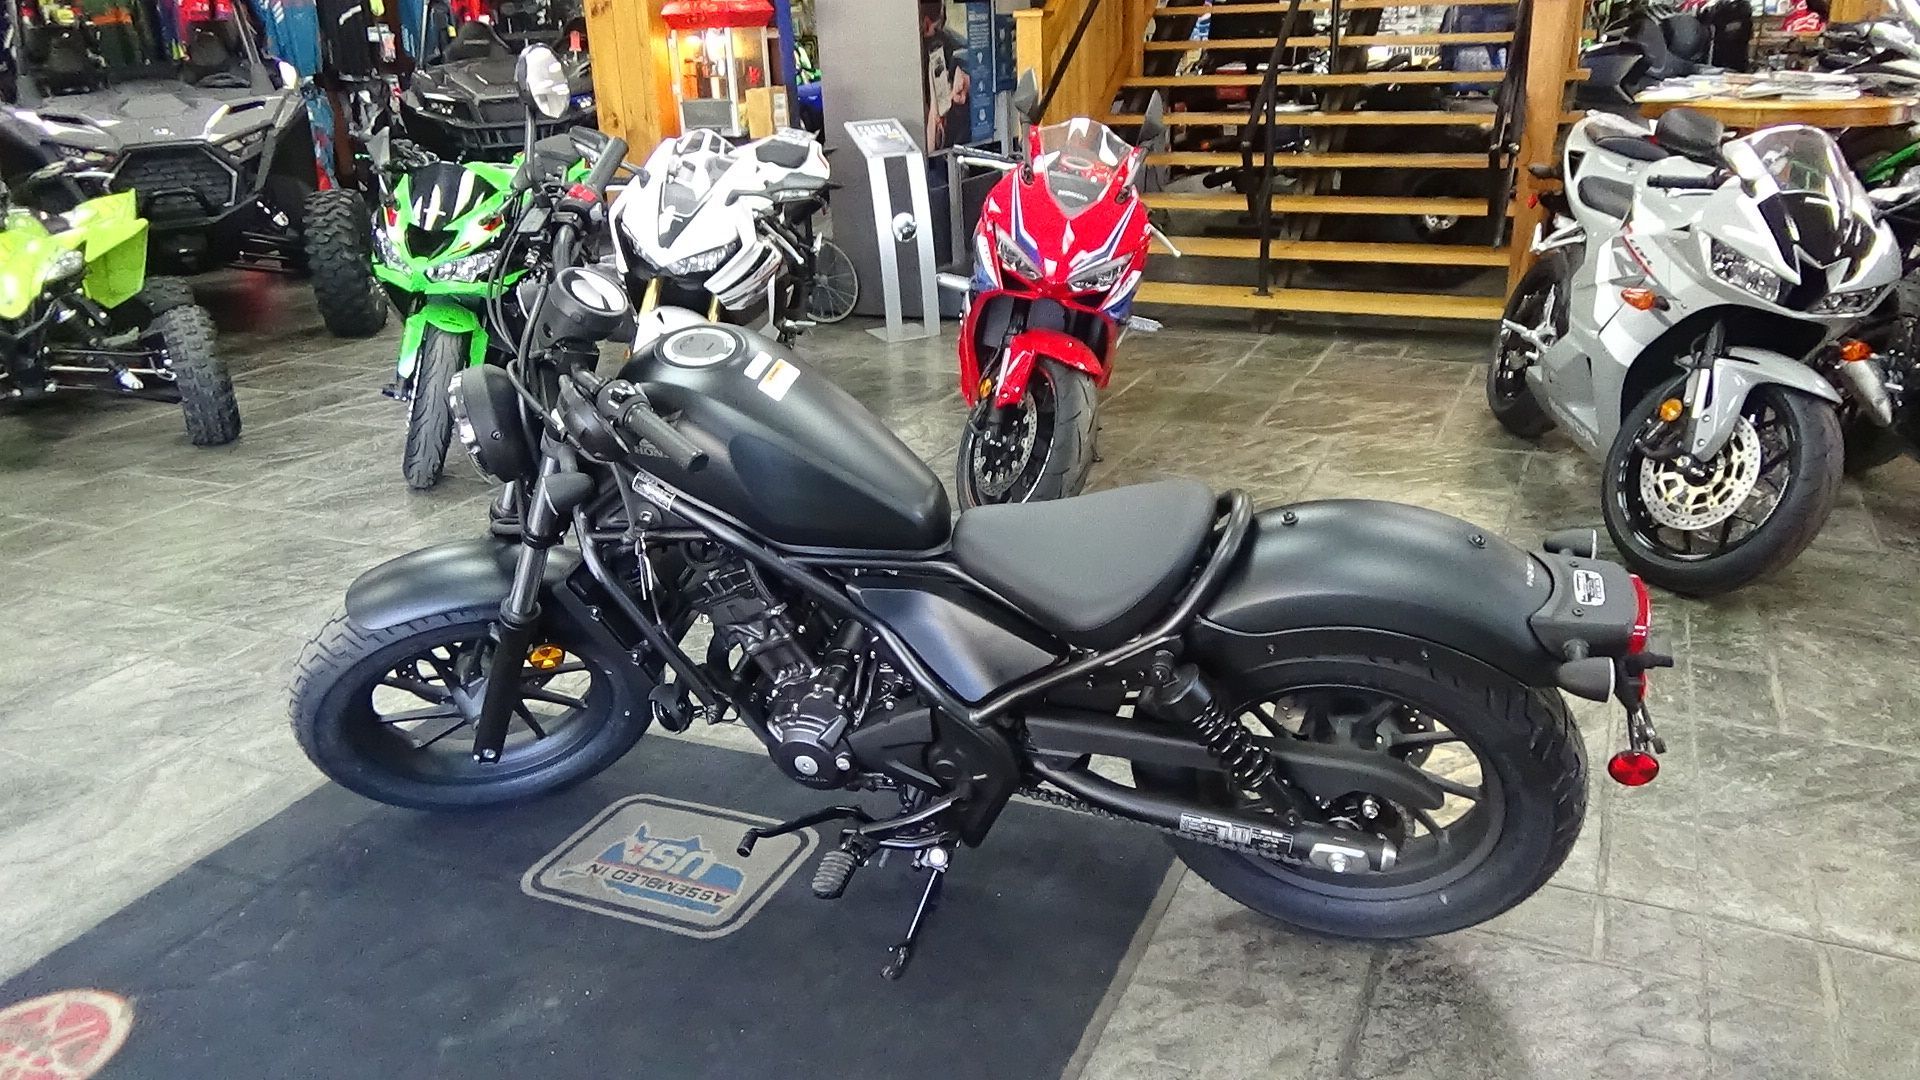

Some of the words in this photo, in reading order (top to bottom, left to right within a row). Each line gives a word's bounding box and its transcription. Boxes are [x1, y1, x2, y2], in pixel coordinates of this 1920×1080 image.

[586, 863, 610, 876] IN
[622, 838, 713, 881] USA
[611, 869, 730, 904] ASSEMBLED
